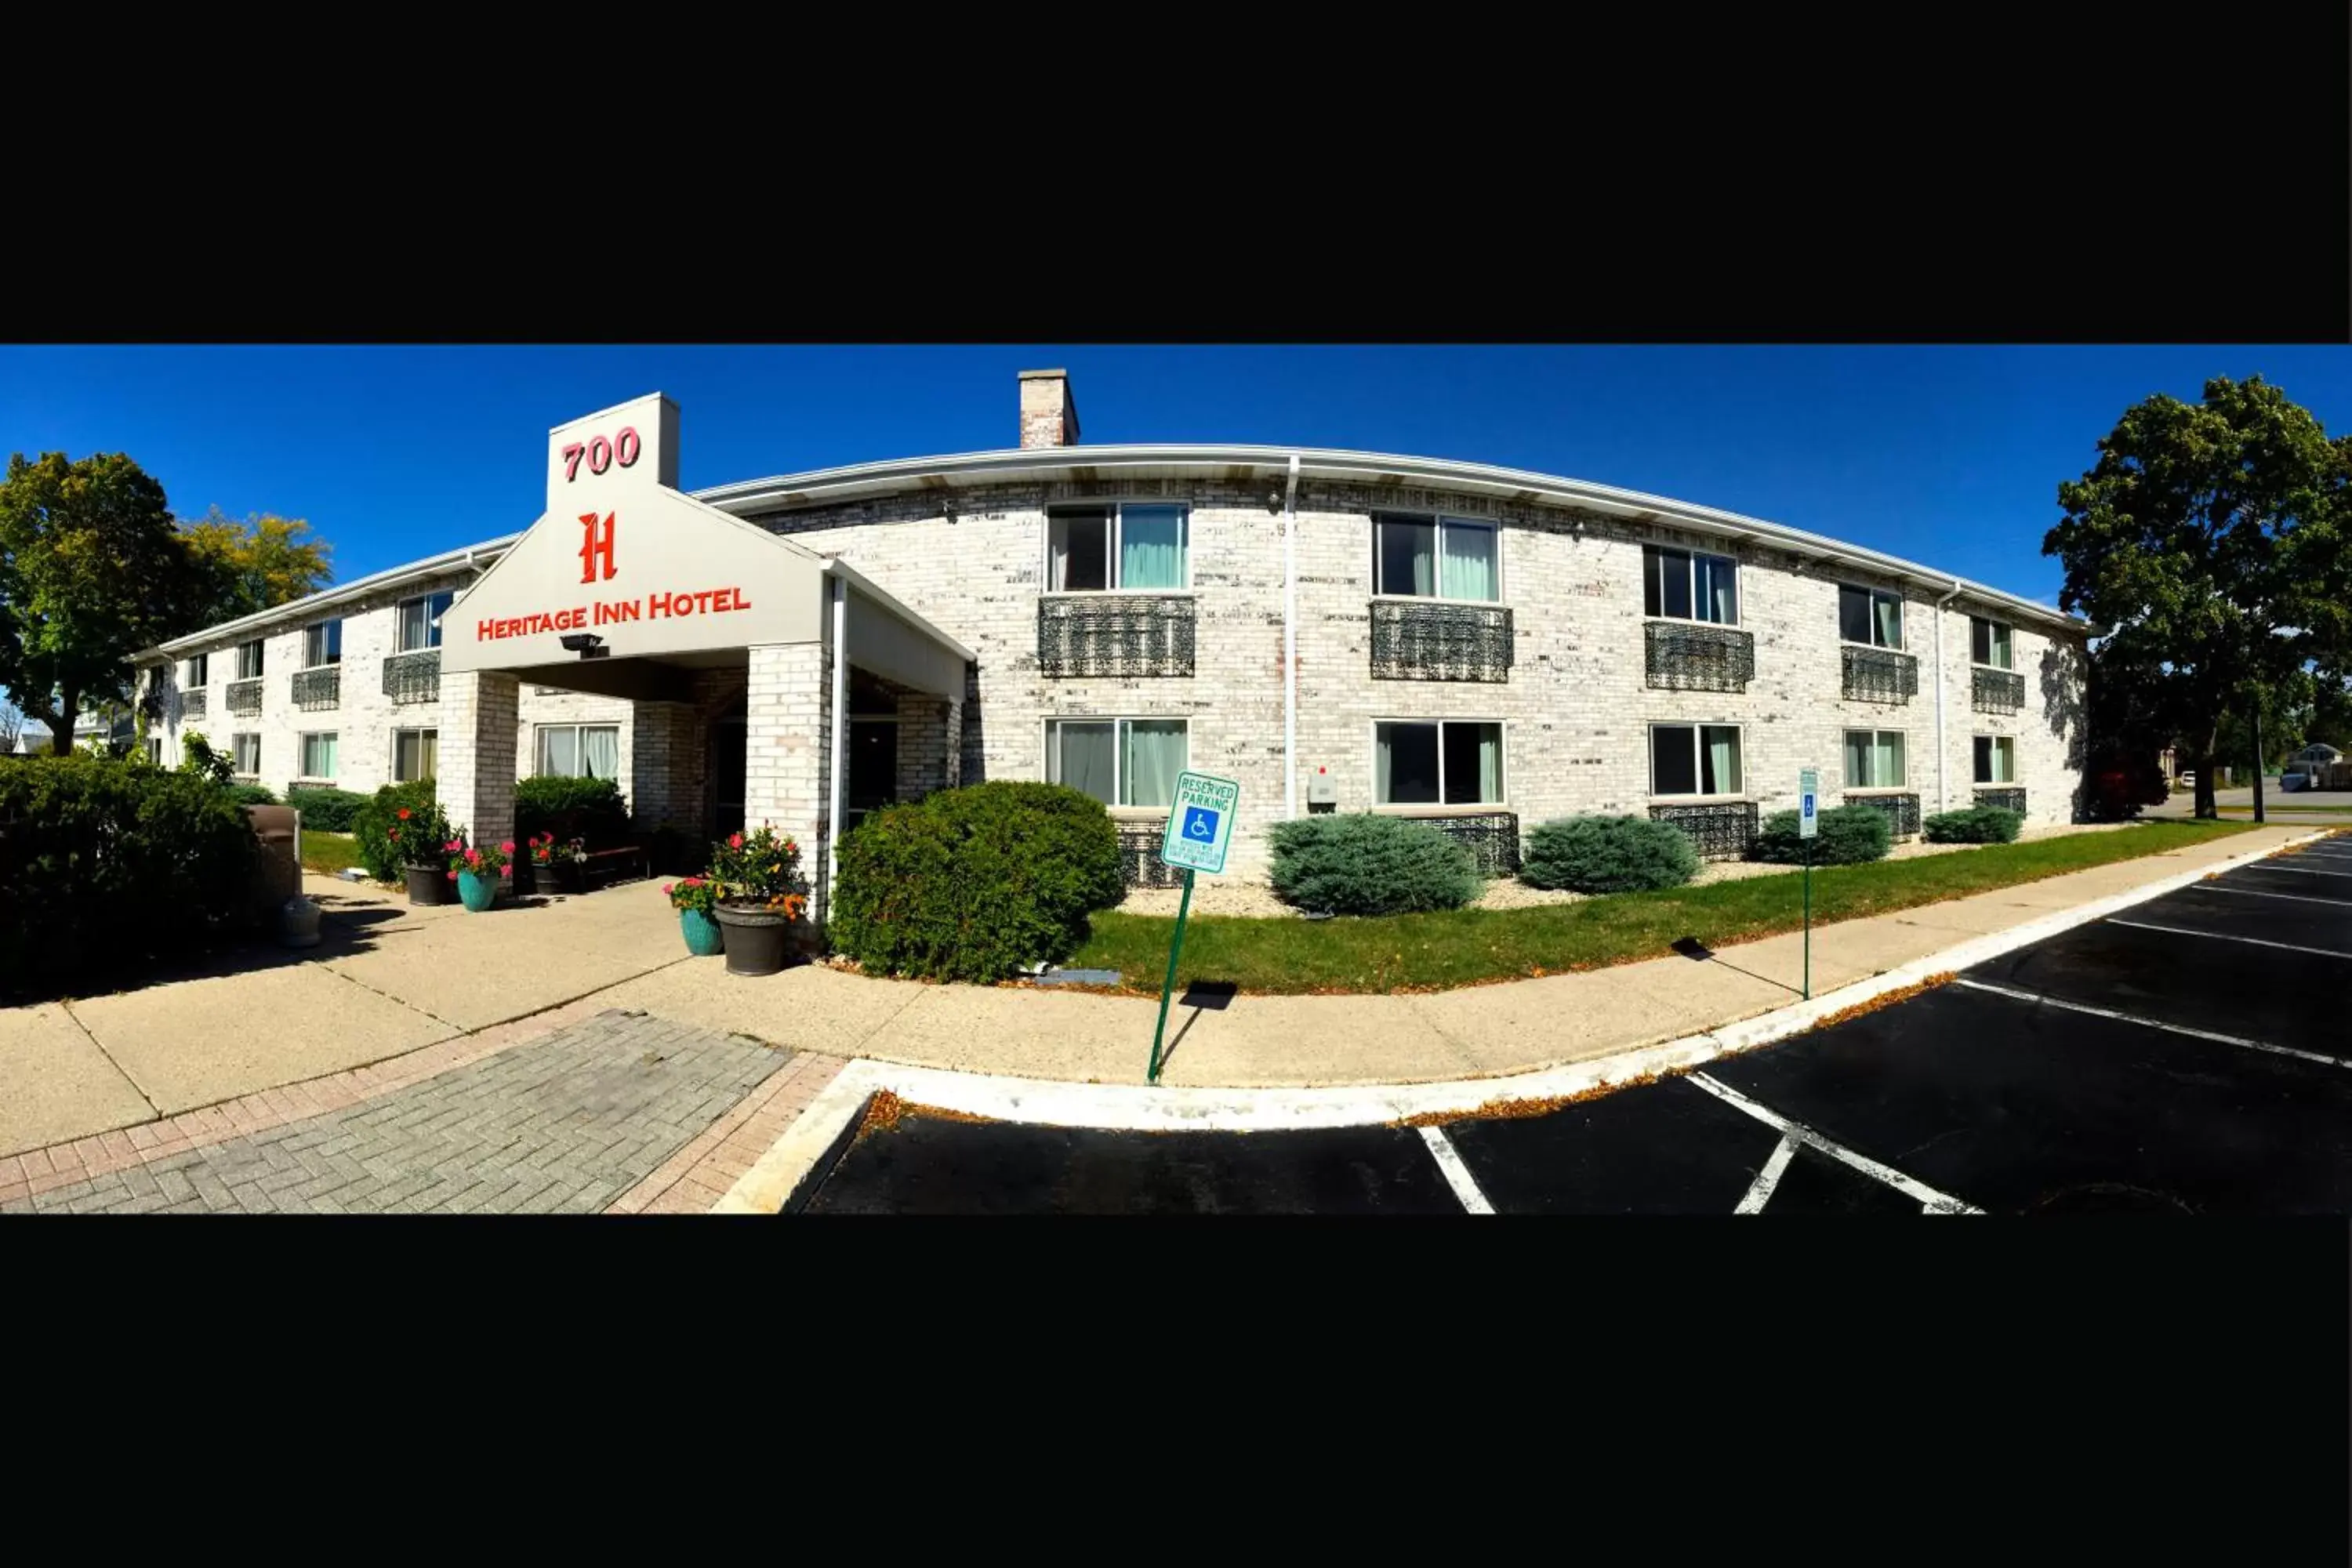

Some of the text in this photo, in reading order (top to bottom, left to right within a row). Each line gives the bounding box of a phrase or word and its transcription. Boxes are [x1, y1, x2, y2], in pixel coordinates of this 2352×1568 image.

[562, 426, 640, 482] 700
[579, 511, 618, 584] H
[477, 587, 751, 641] HERITAGE INN HOTEL
[1181, 778, 1234, 799] RESERVED
[1181, 792, 1229, 811] PARKING
